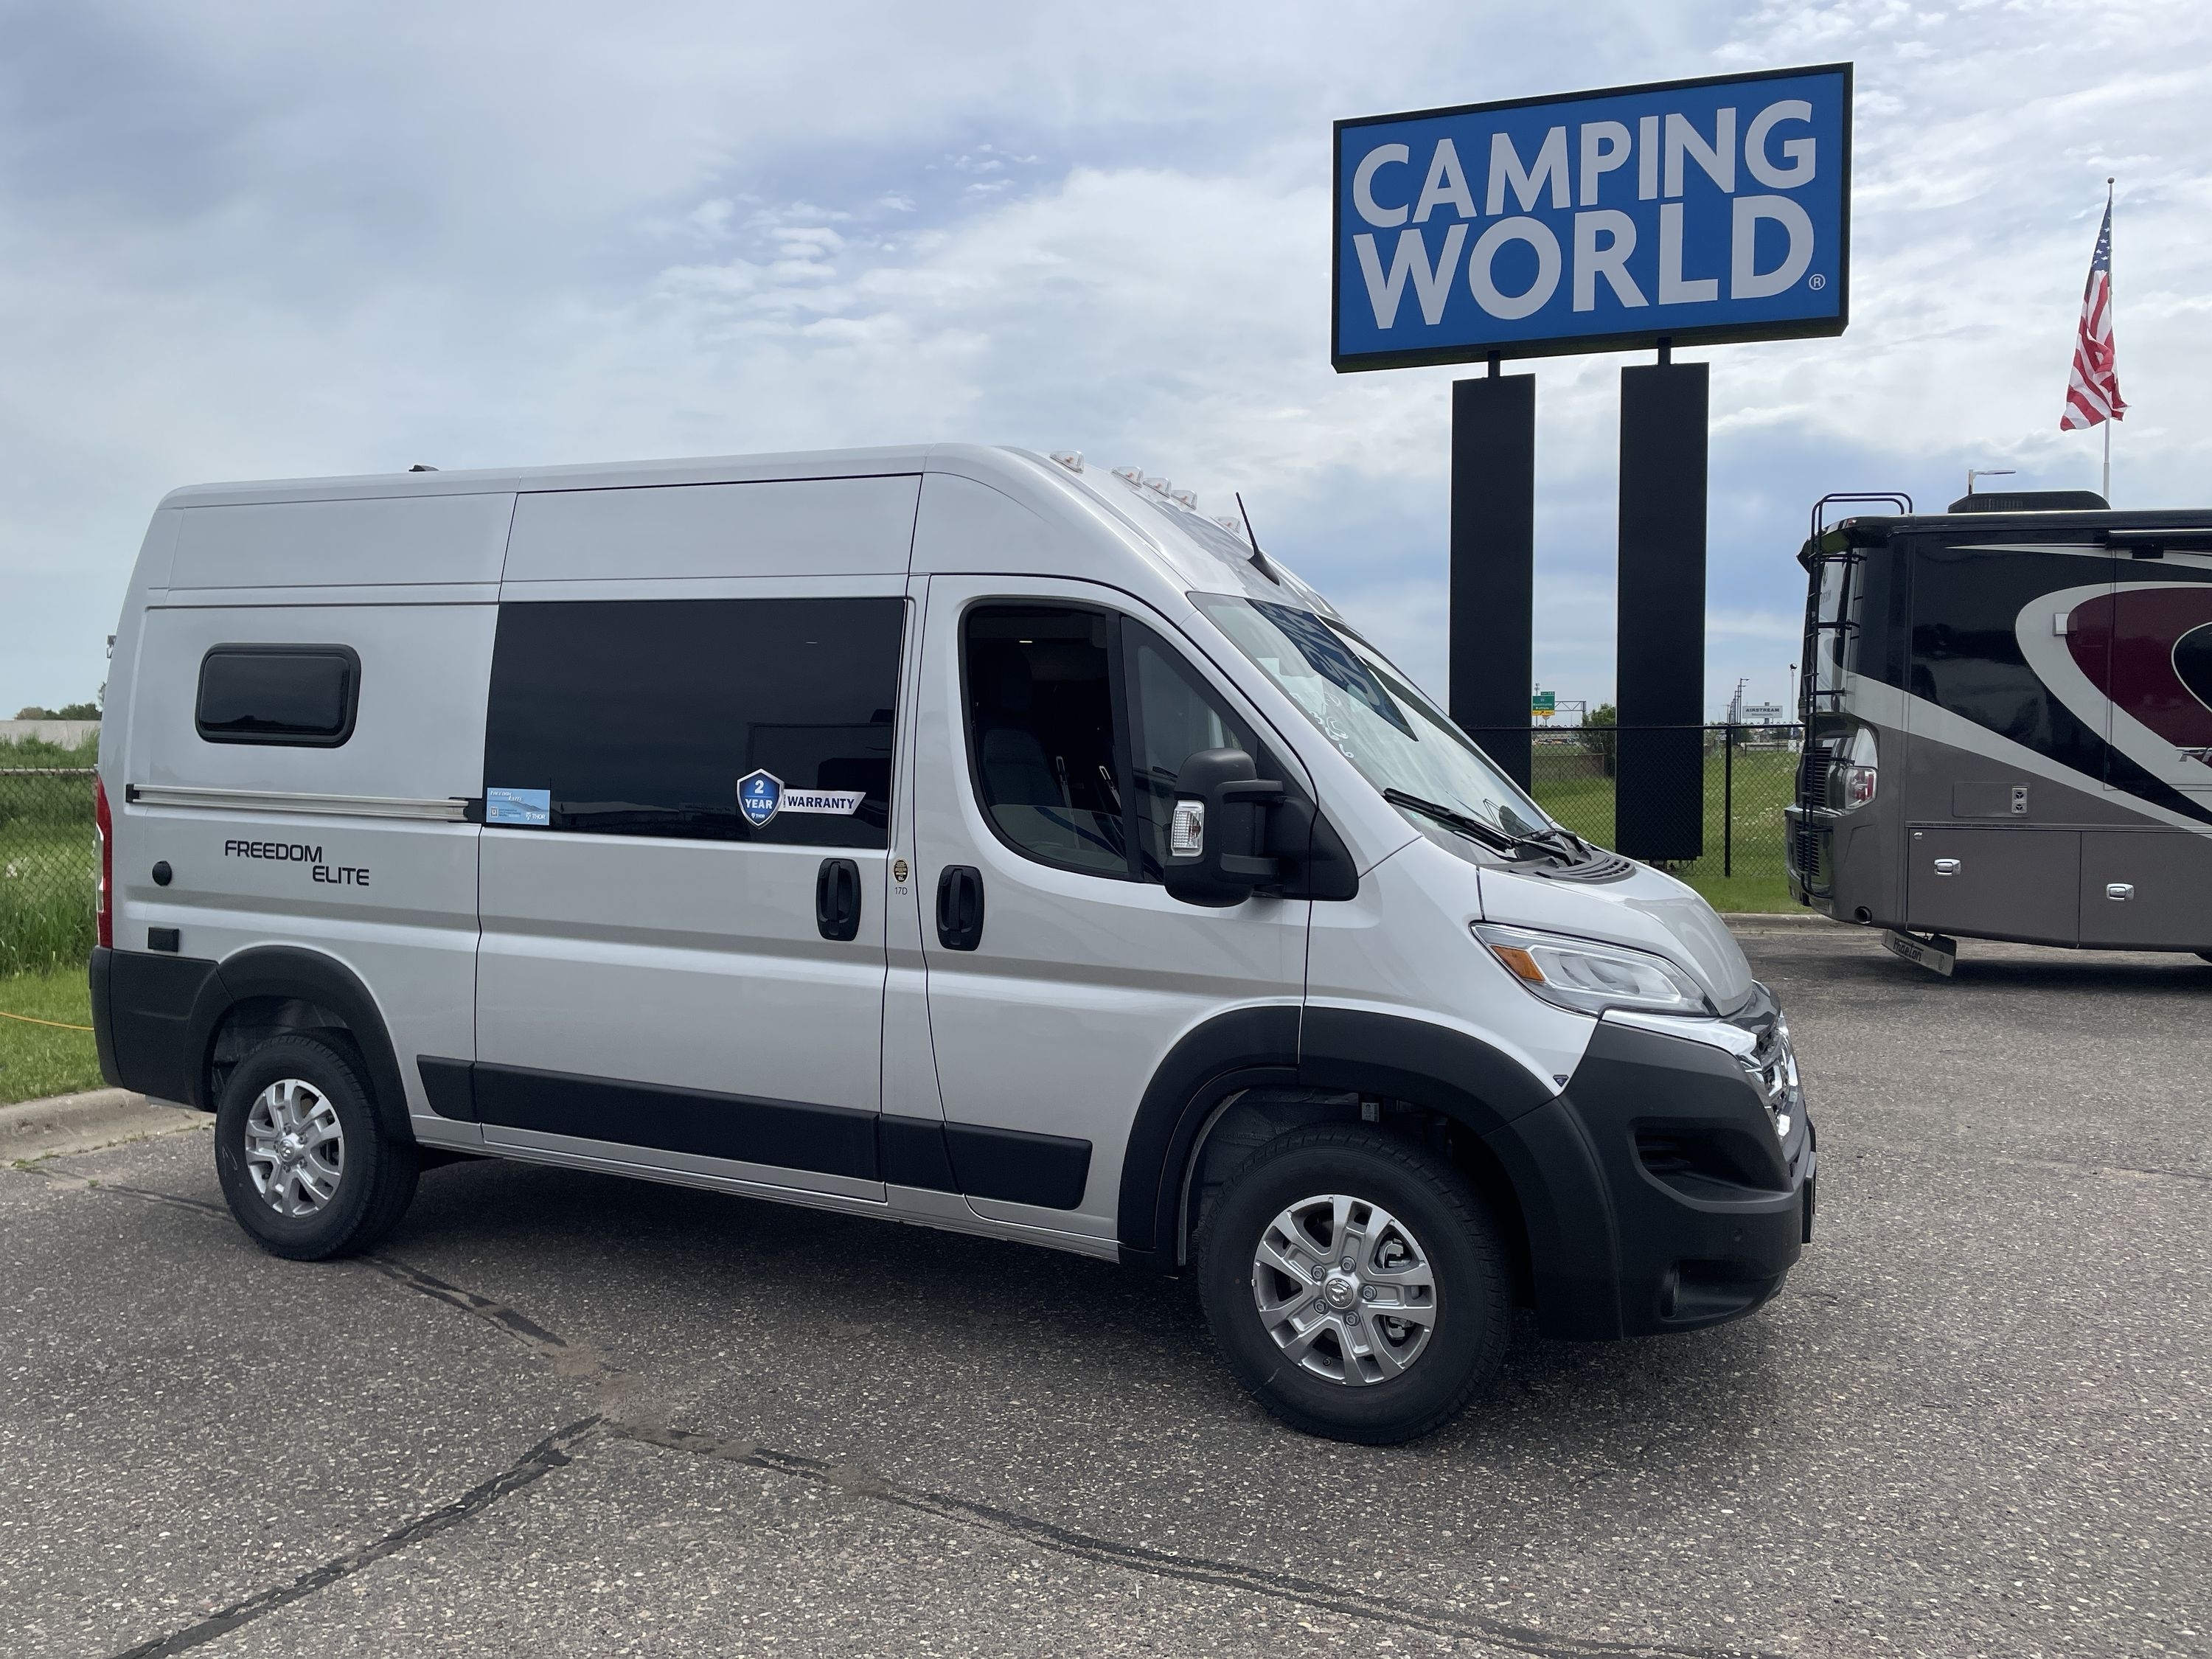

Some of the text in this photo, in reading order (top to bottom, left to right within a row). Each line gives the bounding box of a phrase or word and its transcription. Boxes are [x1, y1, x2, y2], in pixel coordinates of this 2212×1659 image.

[1352, 99, 1817, 228] CAMPING
[1352, 195, 1815, 330] WORLD
[754, 779, 765, 794] 2
[745, 799, 773, 810] YEAR
[787, 796, 855, 810] WARRANTY
[224, 839, 323, 863] FREEDOM
[312, 865, 370, 886] ELITE
[895, 886, 908, 895] 17D
[1893, 937, 1924, 961] Phaeton
